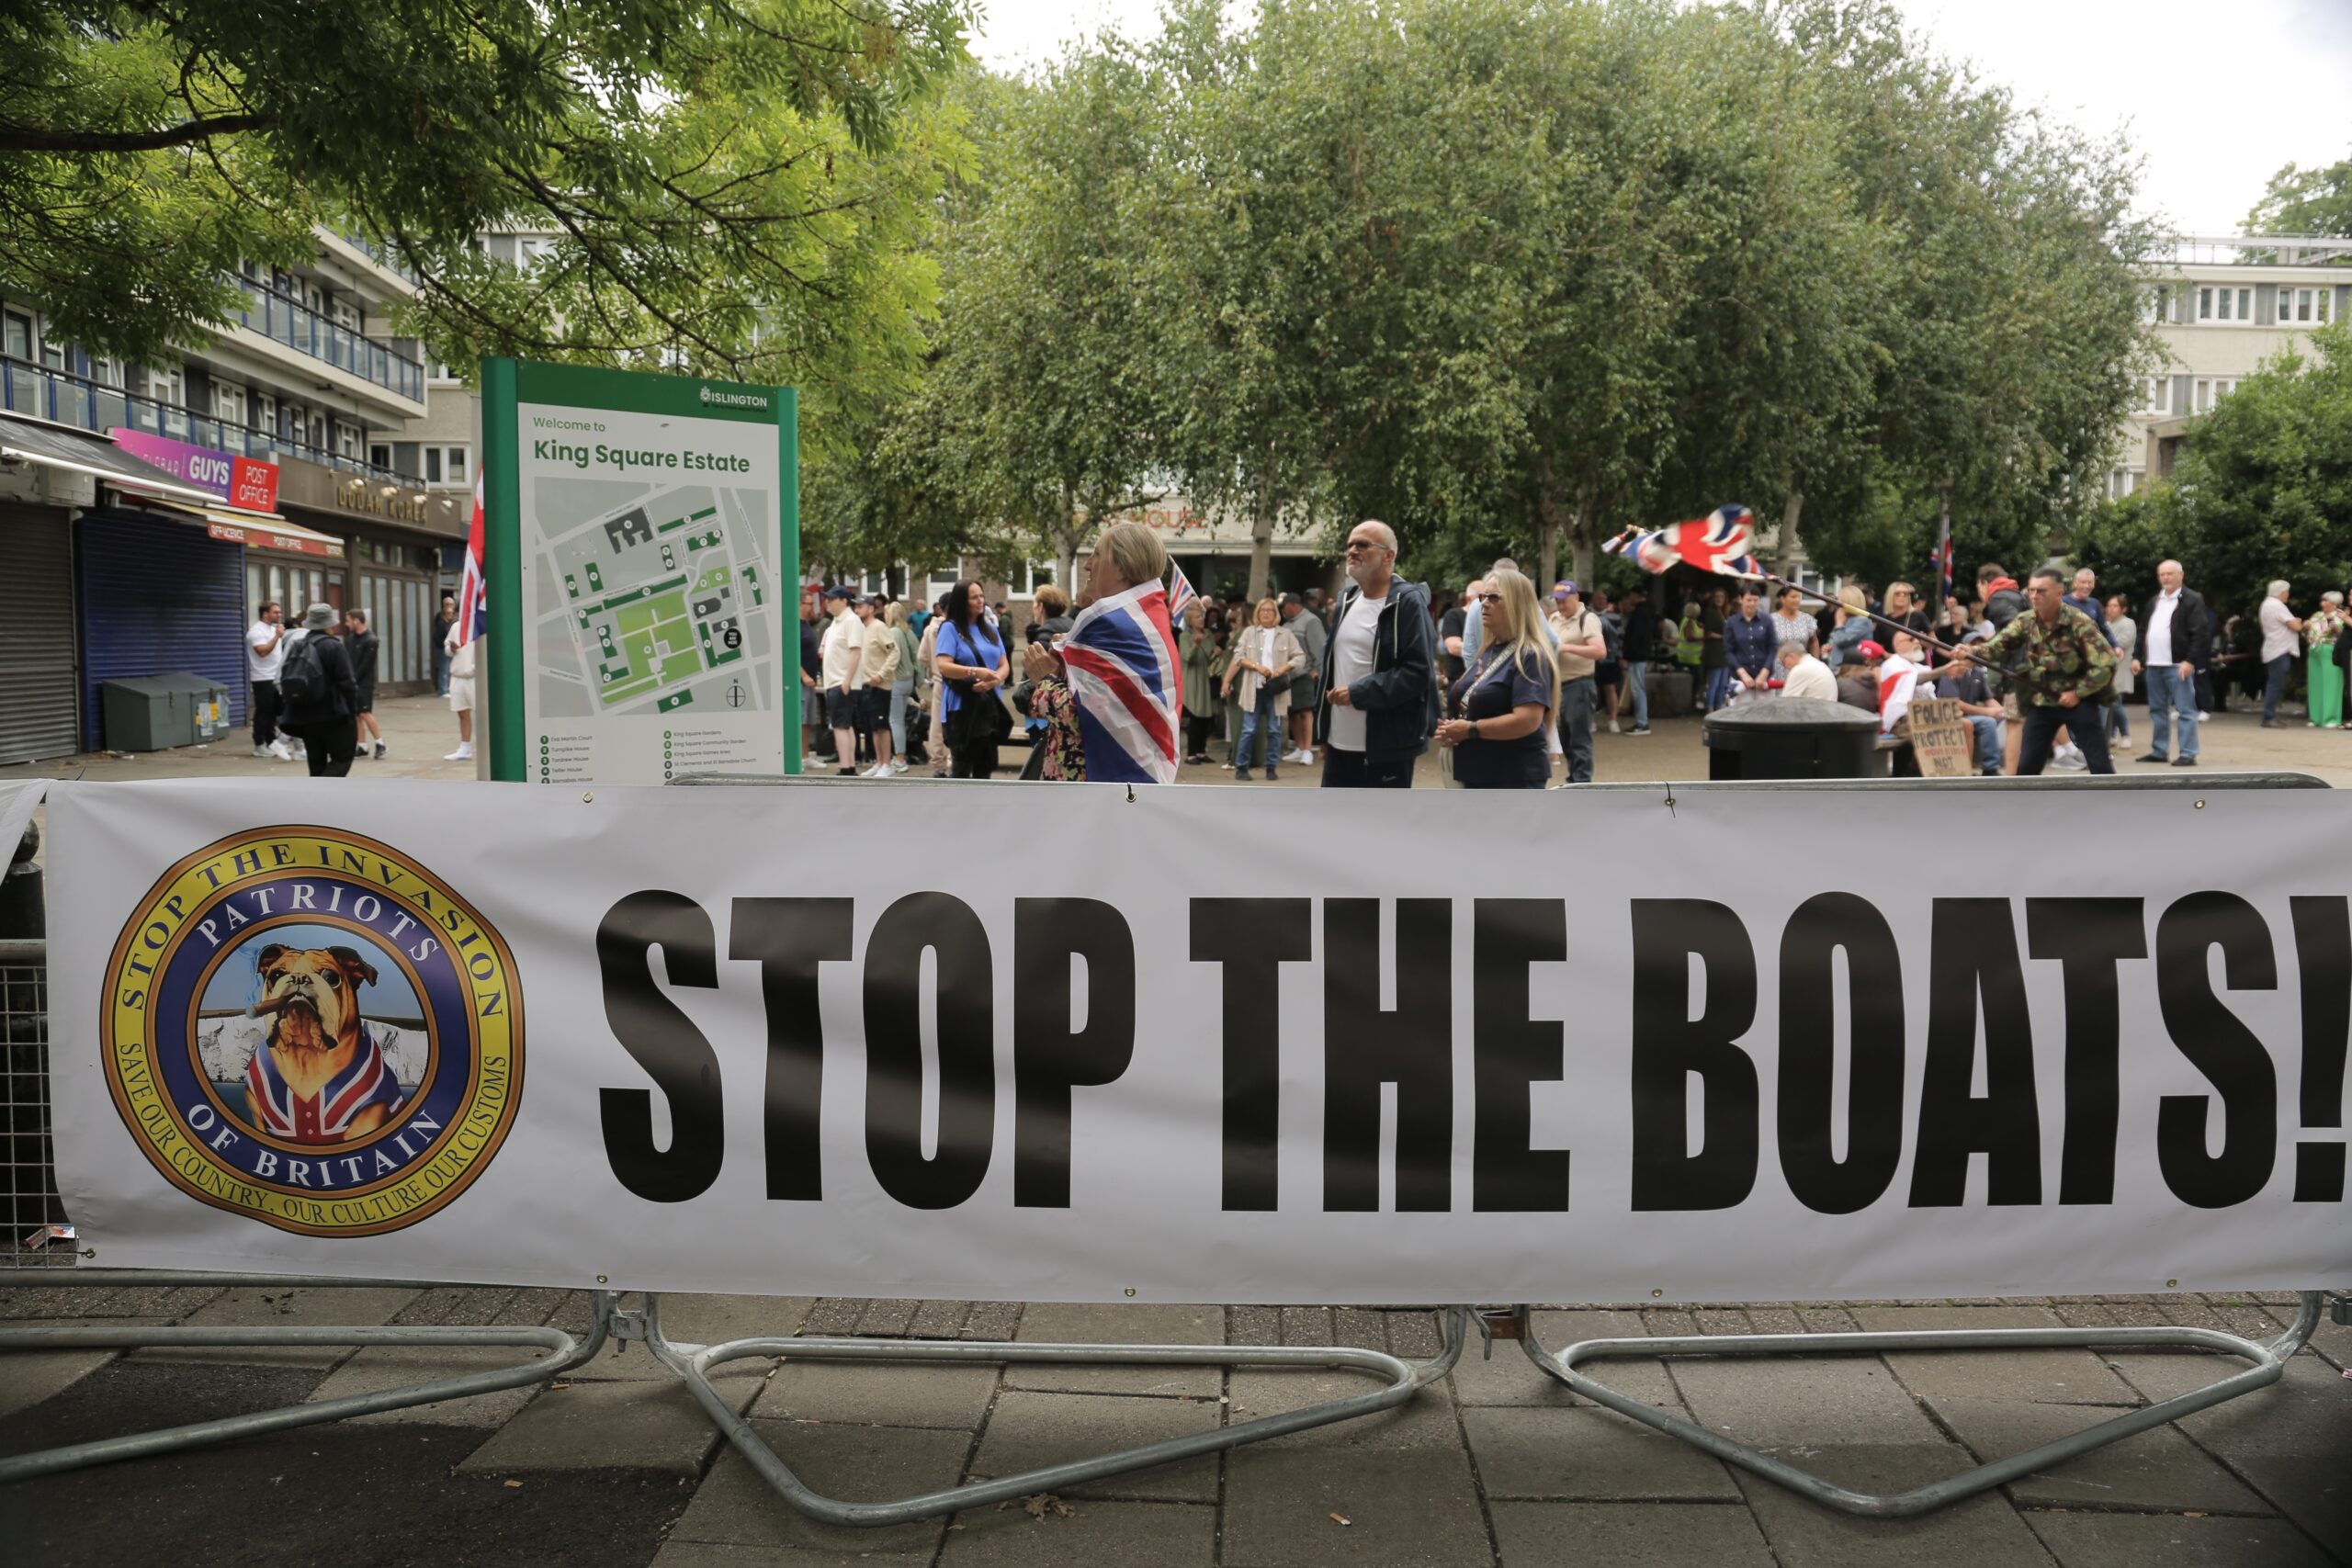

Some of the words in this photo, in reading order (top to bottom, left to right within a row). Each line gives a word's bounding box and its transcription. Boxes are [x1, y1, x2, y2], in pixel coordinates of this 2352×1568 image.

[711, 392, 768, 408] ISLINGTON
[533, 416, 592, 432] Welcome
[594, 422, 606, 433] to
[534, 439, 589, 468] King
[595, 445, 678, 471] Square
[683, 450, 751, 472] Estate
[189, 455, 230, 486] GUYS
[245, 465, 269, 485] POST
[239, 484, 269, 505] OFFICE
[1913, 702, 1959, 724] POLICE
[1914, 728, 1964, 748] PROTECT
[1933, 757, 1953, 769] NOT
[122, 895, 187, 1010] STOP
[196, 843, 297, 891] THE
[317, 844, 503, 1018] INVASION
[196, 884, 440, 962] PATRIOTS
[595, 888, 1136, 1211] STOP
[1189, 897, 1571, 1213] THE
[1630, 889, 2352, 1215] BOATS!
[119, 1043, 154, 1102] SAVE
[140, 1103, 177, 1150] OUR
[172, 1146, 276, 1214] COUNTRY,
[282, 1198, 328, 1224] OUR
[331, 1179, 428, 1224] CULTURE
[424, 1148, 464, 1189] OUR
[457, 1055, 507, 1151] CUSTOMS
[187, 1104, 240, 1152] OF
[252, 1109, 443, 1188] BRITAIN
